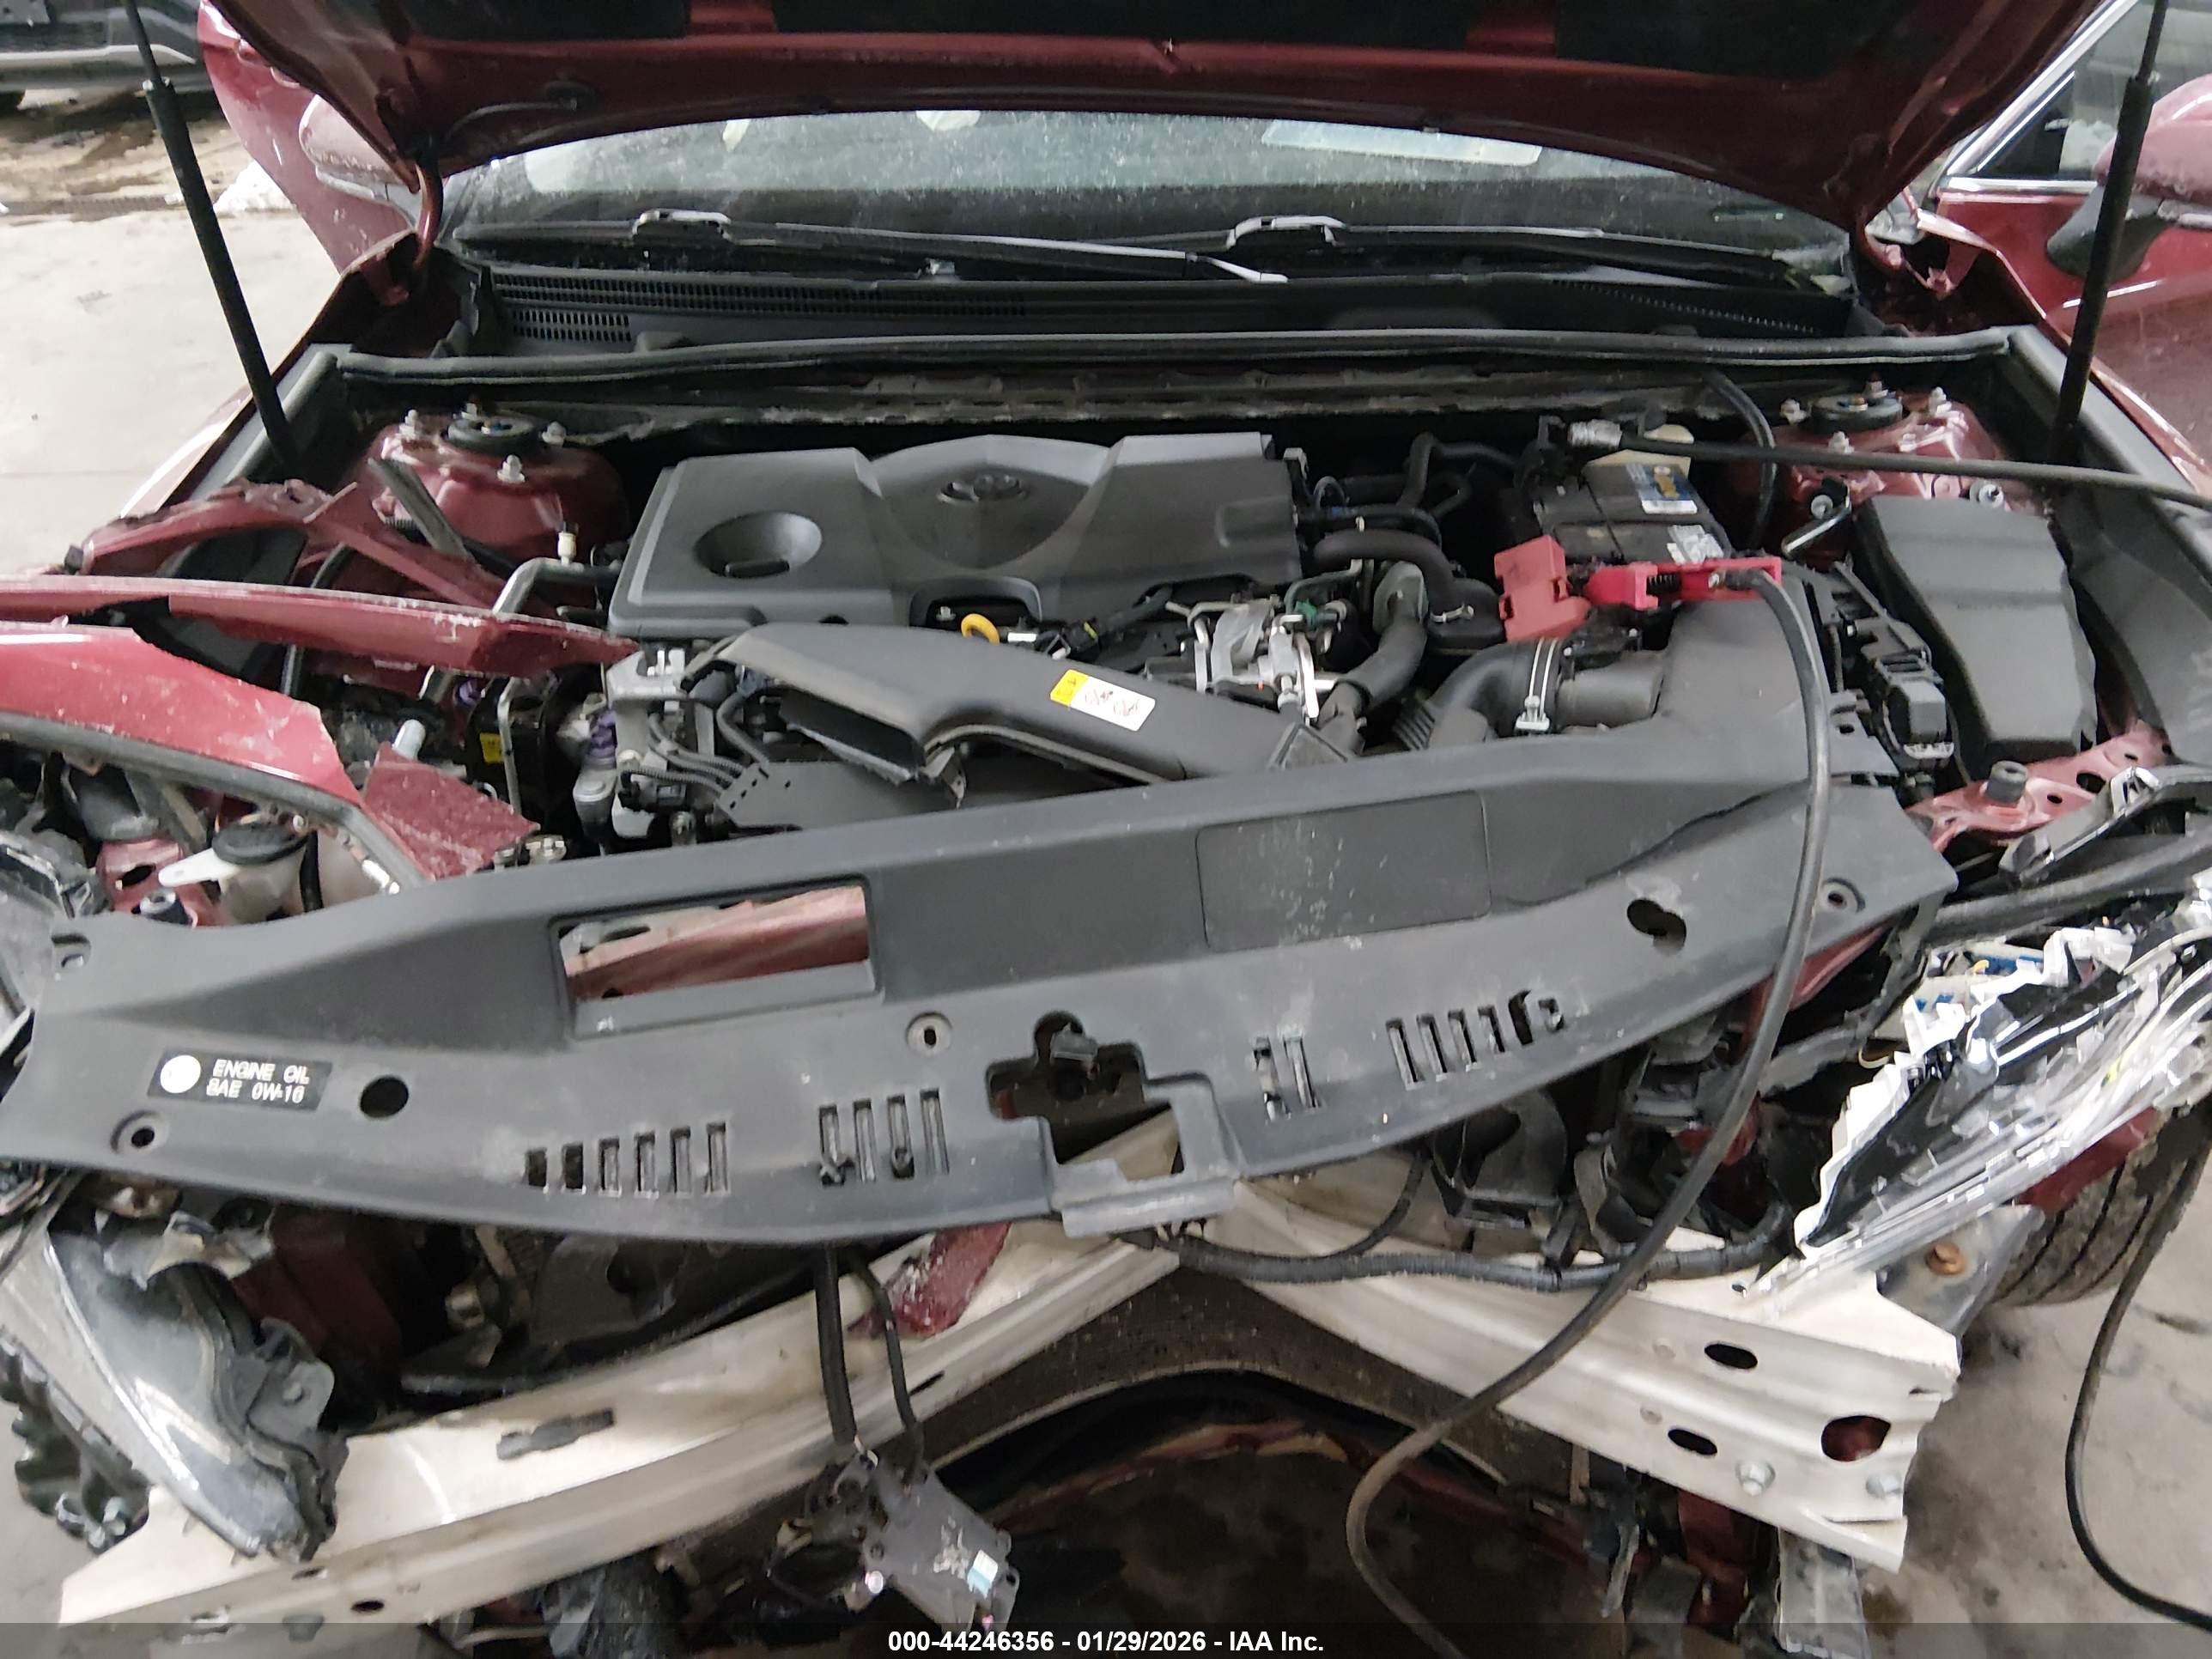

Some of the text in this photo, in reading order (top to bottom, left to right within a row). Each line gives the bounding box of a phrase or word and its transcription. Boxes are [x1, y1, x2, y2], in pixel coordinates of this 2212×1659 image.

[212, 1059, 310, 1085] ENGINE OIL
[206, 1078, 242, 1098] SAE
